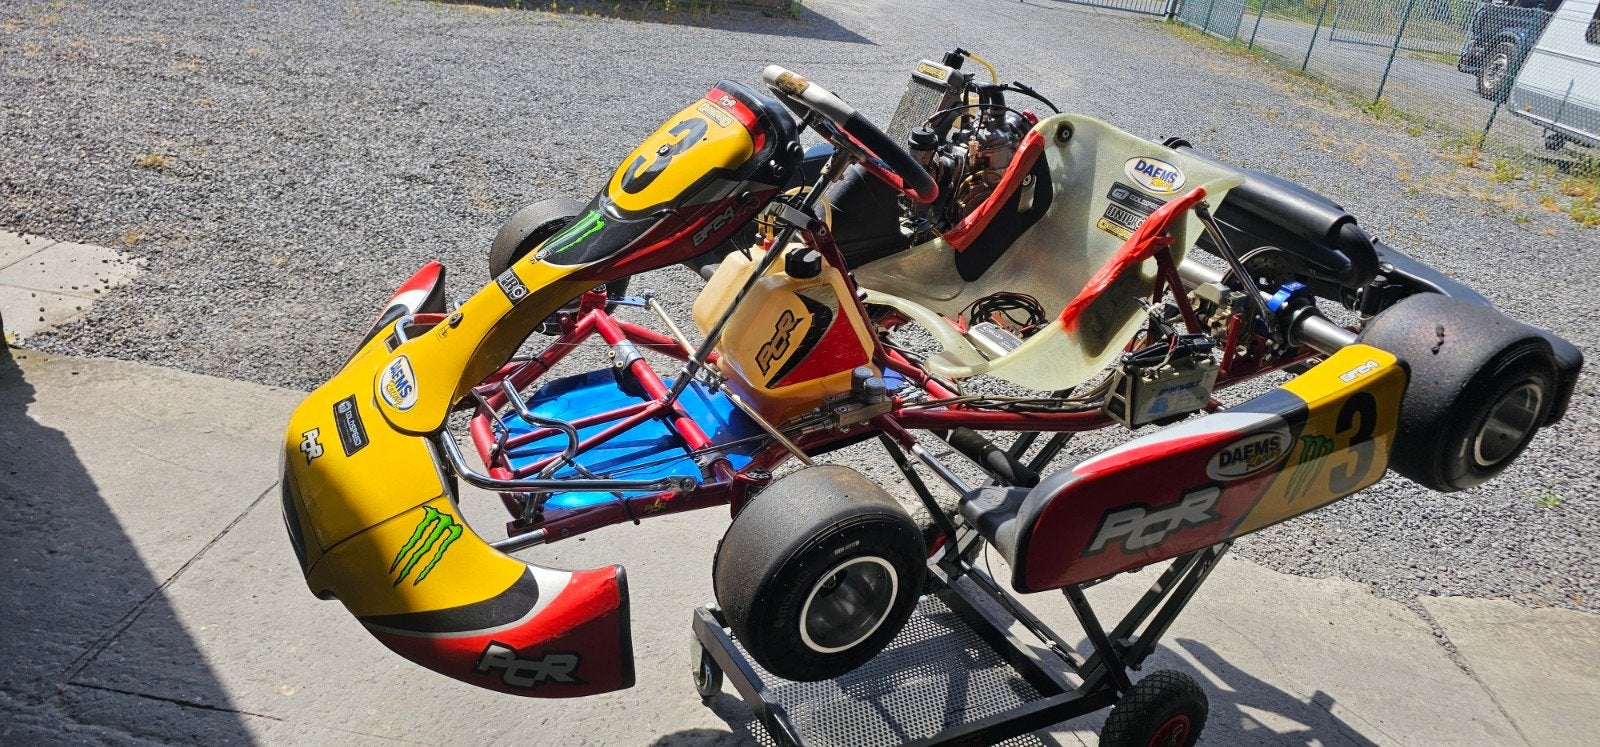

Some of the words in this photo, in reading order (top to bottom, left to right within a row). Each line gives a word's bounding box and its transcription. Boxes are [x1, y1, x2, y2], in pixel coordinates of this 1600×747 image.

[620, 117, 708, 195] 3
[756, 310, 802, 375] PCR
[300, 428, 324, 464] PCR
[1219, 435, 1280, 468] DAEMS
[1329, 391, 1378, 494] 3
[1086, 485, 1222, 551] PCR
[475, 642, 583, 688] PCR
